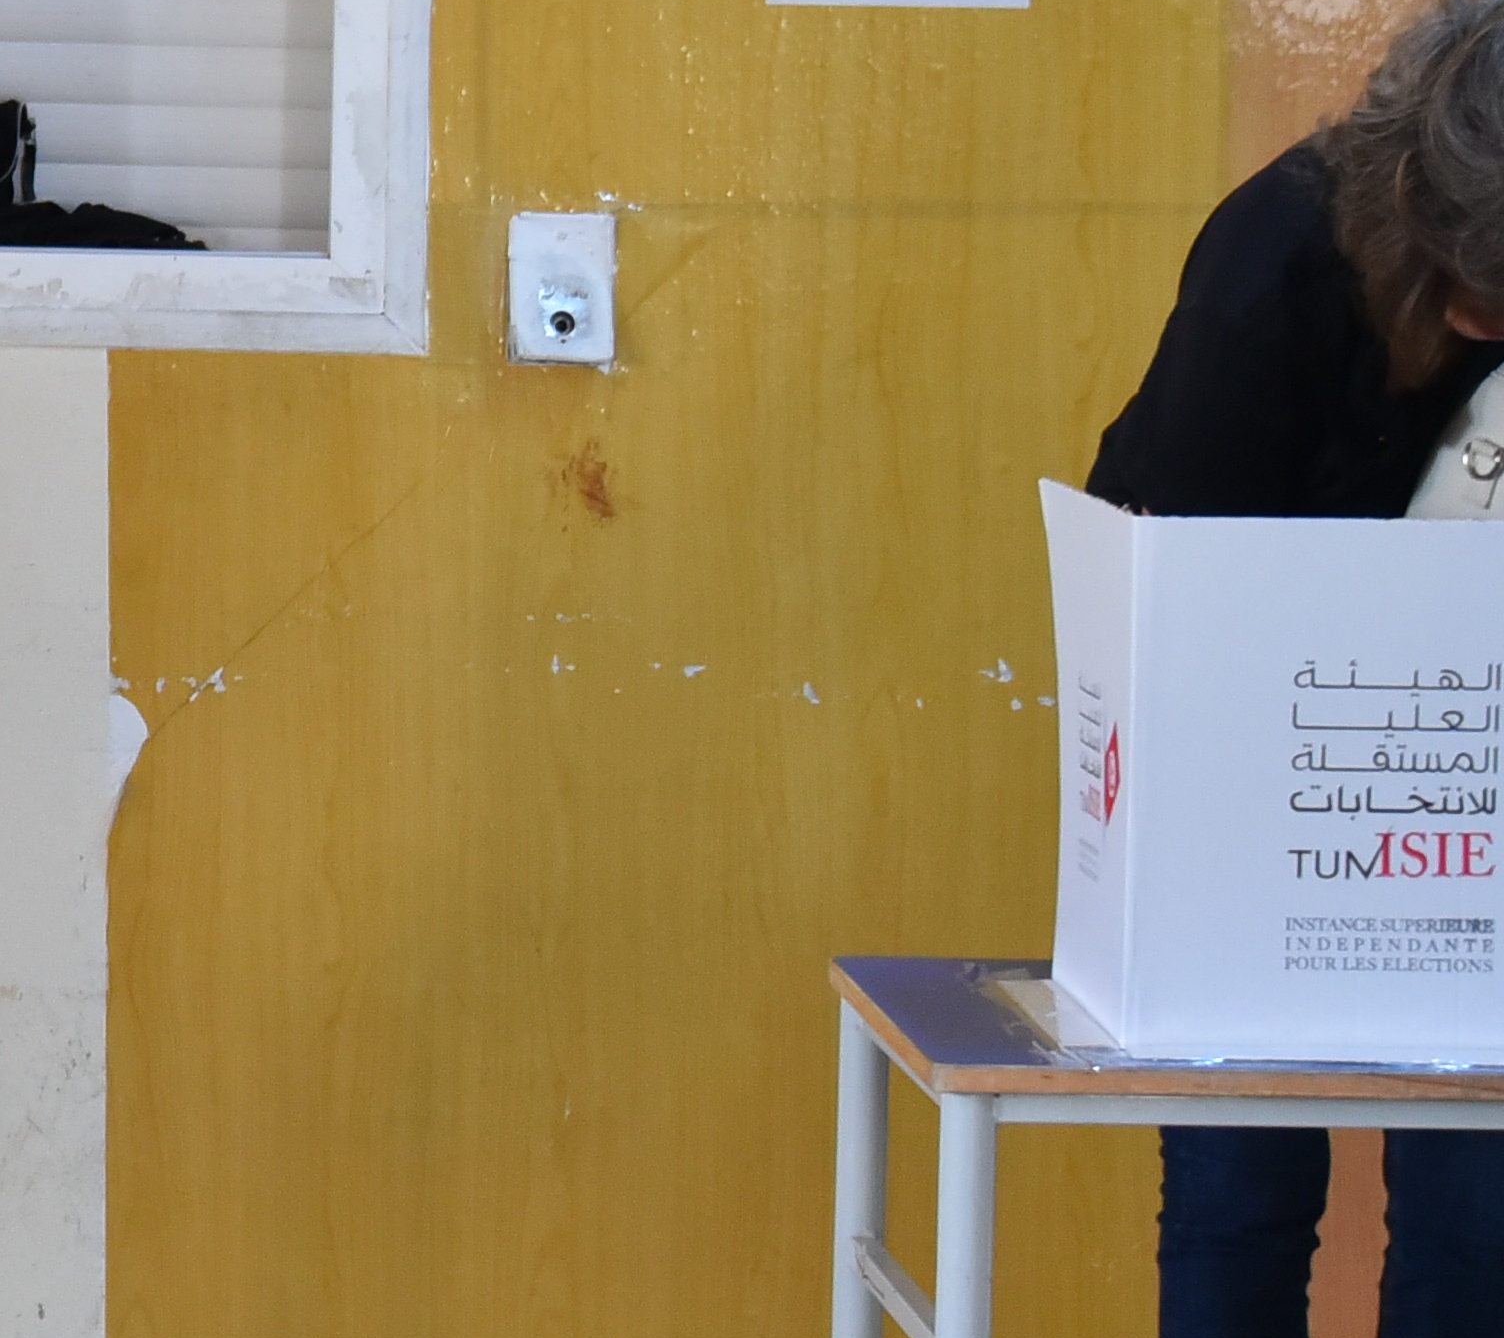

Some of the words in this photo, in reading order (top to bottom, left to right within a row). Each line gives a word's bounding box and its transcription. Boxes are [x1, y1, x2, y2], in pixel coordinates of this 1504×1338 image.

[1293, 659, 1502, 697] الهيئة
[1293, 702, 1500, 739] العليا
[1291, 743, 1498, 775] المستقلة
[1289, 784, 1497, 821] للانتخابات
[1284, 917, 1378, 933] INSTANCE
[1381, 918, 1495, 934] SUPERIEURE
[1284, 937, 1494, 953] INDEPENDANTE
[1284, 957, 1337, 972] POUR
[1343, 957, 1377, 972] LES
[1382, 957, 1494, 974] ELECTIONS
